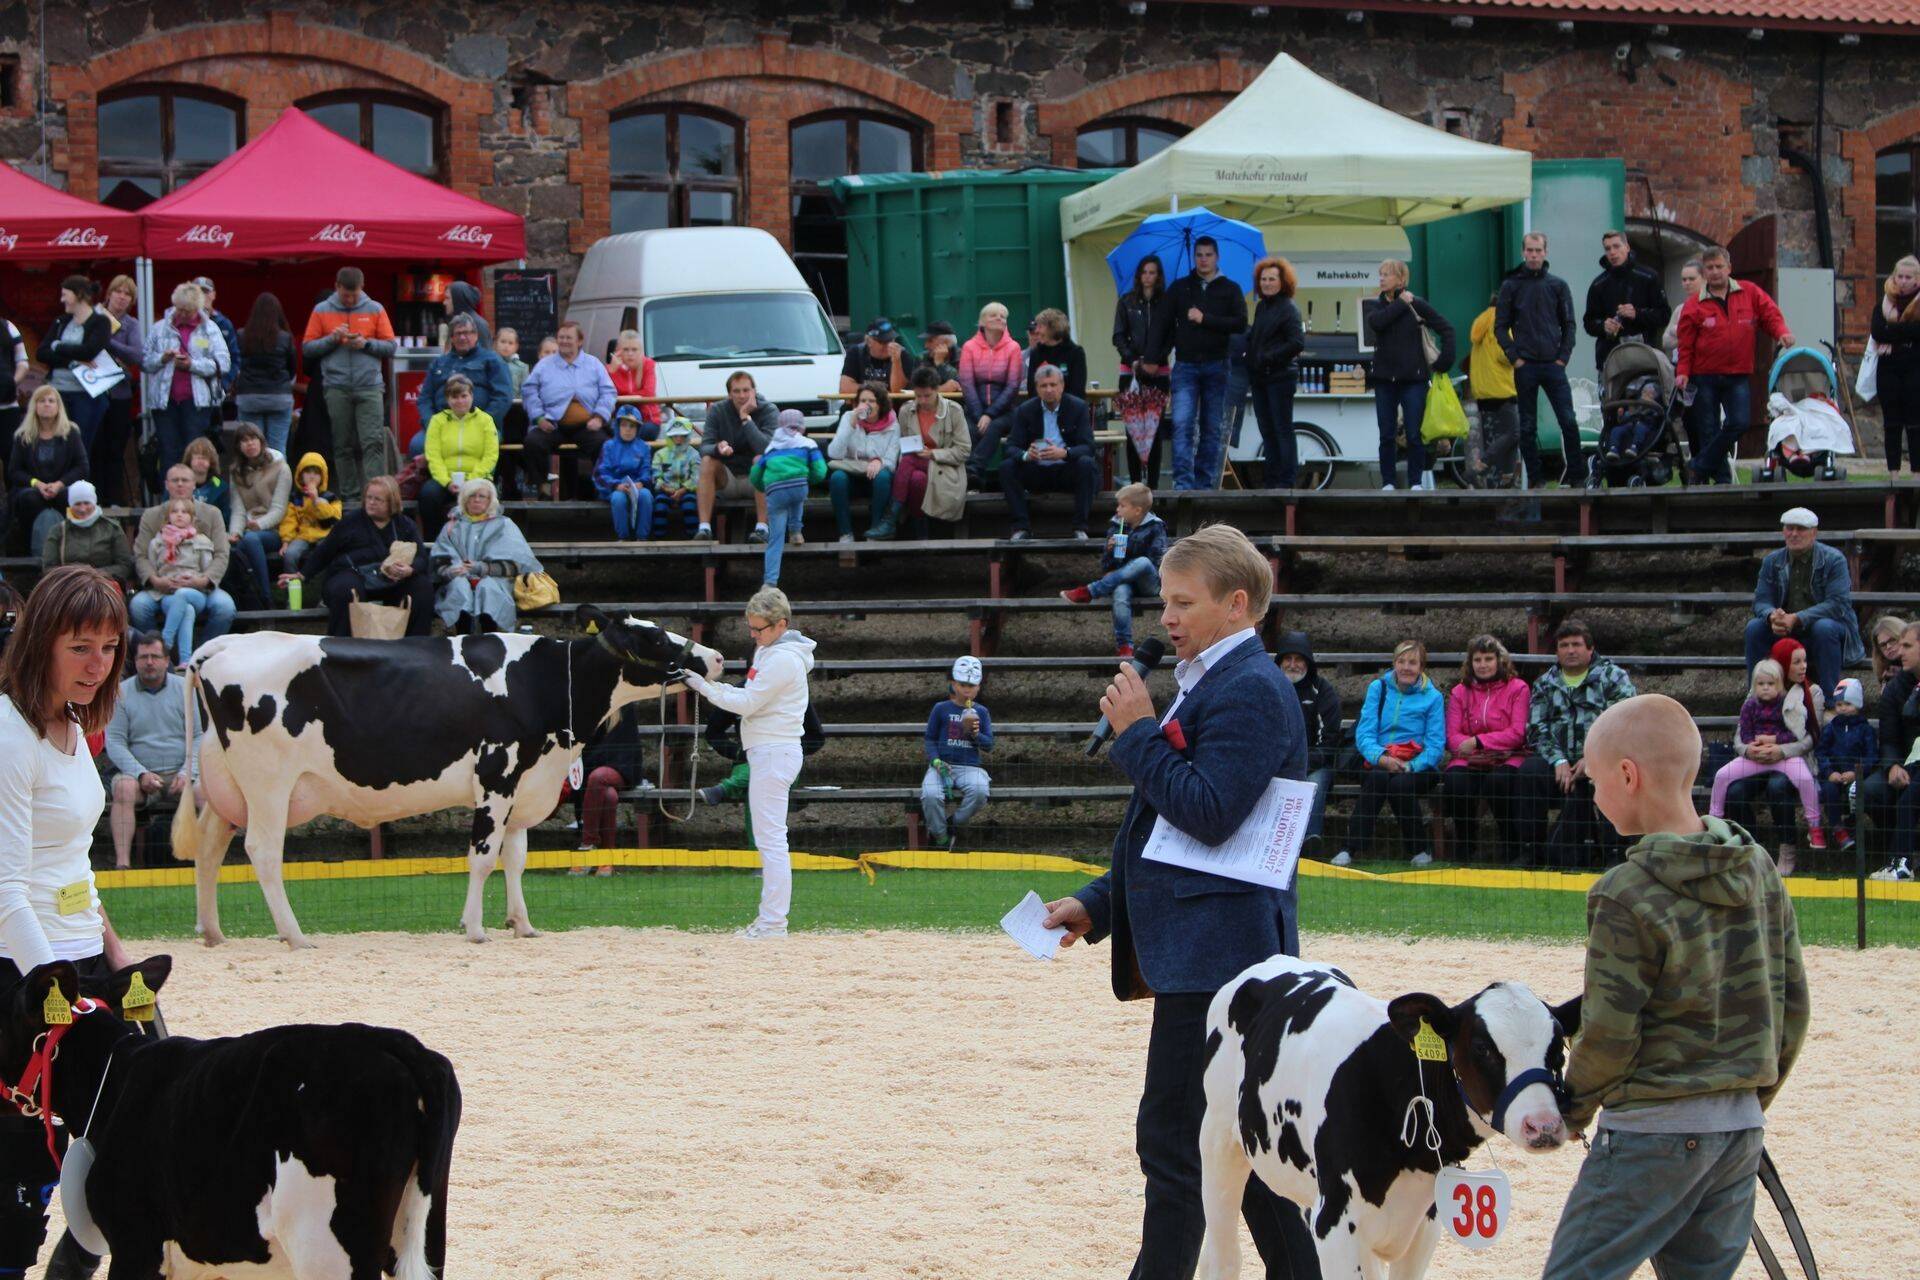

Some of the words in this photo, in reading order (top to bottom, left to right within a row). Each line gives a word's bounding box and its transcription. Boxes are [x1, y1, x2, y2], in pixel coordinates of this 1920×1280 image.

[1317, 271, 1370, 280] Mahekohv
[1265, 849, 1280, 872] 2017
[1453, 1183, 1498, 1239] 38
